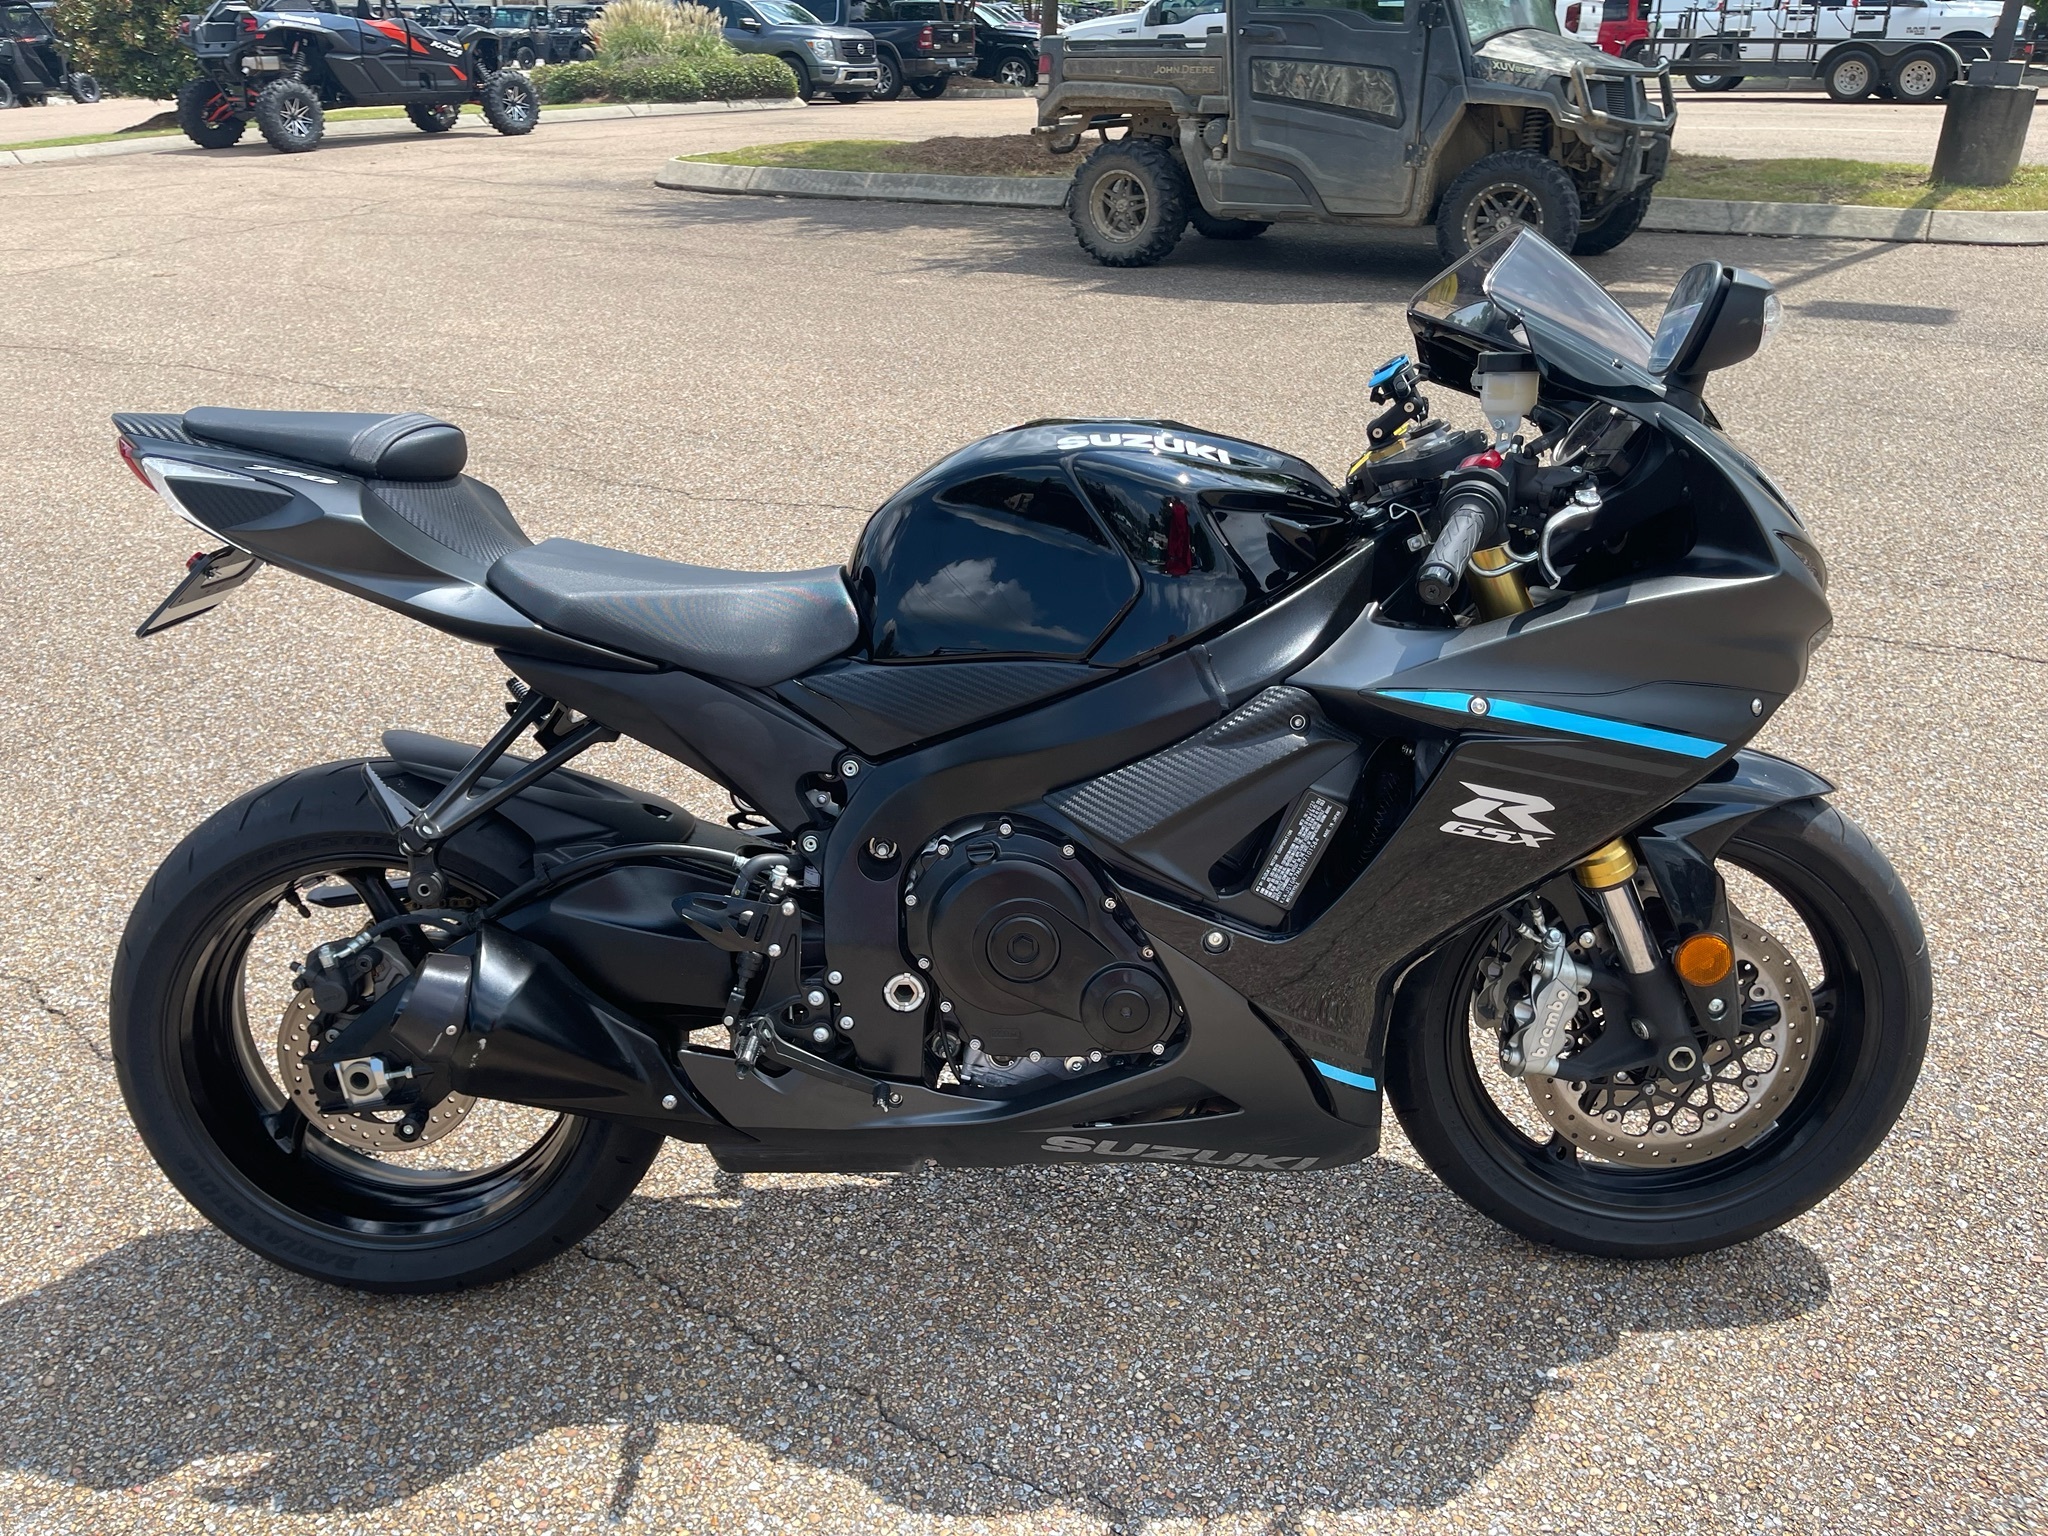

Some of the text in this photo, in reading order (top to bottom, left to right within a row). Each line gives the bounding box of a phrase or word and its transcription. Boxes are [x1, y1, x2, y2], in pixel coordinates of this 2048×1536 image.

[1154, 64, 1216, 74] JOHN DEERE
[1057, 433, 1231, 465] SUZUKI
[1451, 780, 1556, 835] R
[1440, 820, 1554, 848] GSX
[1530, 990, 1570, 1058] brembo
[1041, 1136, 1320, 1170] SUZUKI
